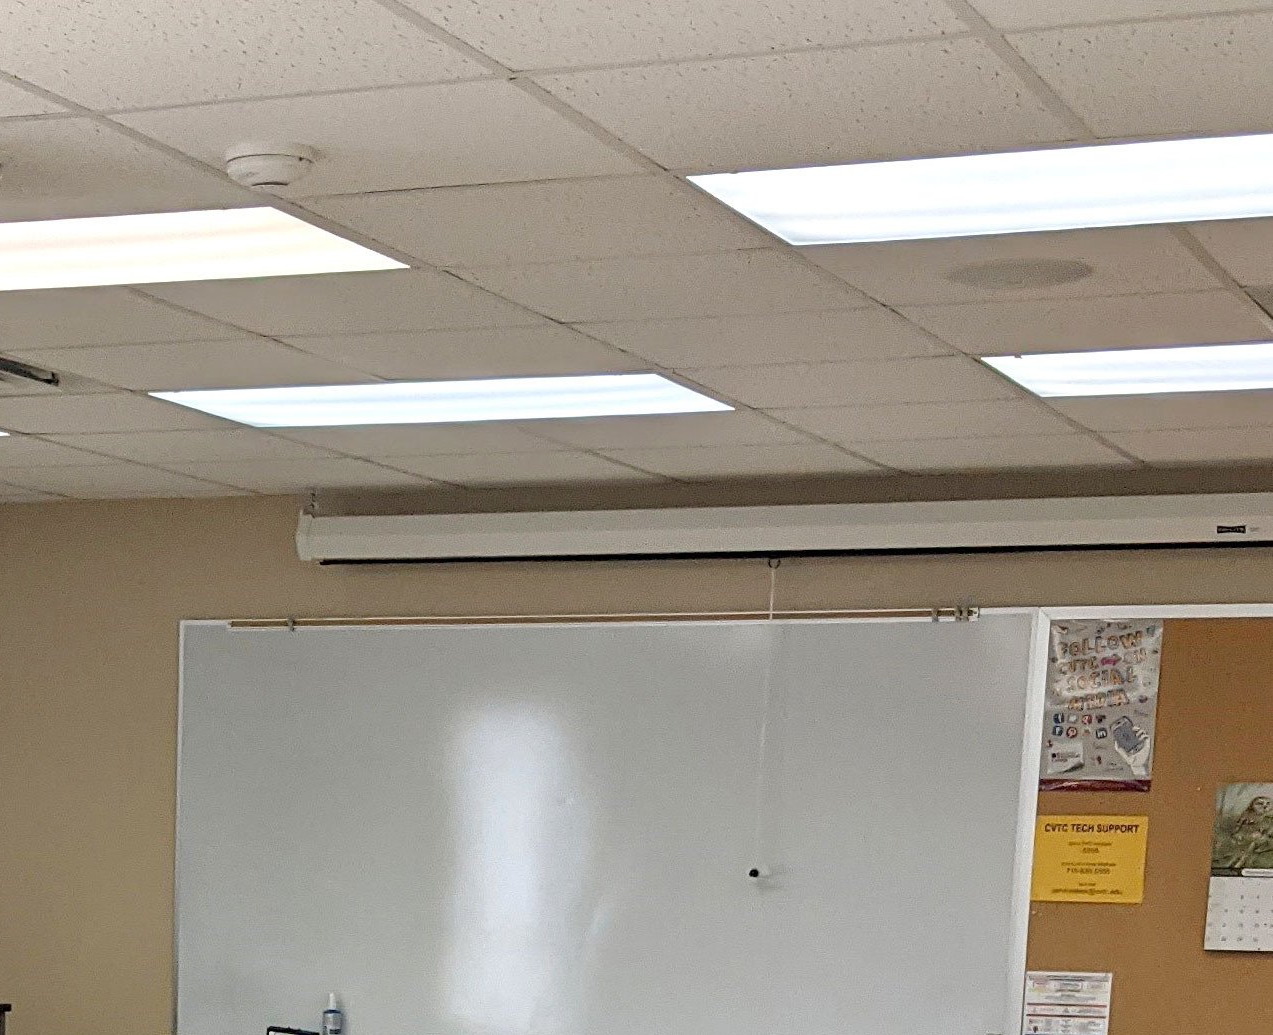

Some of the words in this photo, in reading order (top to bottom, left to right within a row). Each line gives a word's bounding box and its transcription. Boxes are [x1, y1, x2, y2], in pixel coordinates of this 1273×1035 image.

[1057, 631, 1143, 658] FOLLOW
[1067, 667, 1137, 692] SOCIAL
[1044, 823, 1068, 833] CVTC
[1071, 824, 1095, 833] TECH
[1096, 824, 1139, 833] SUPPORT
